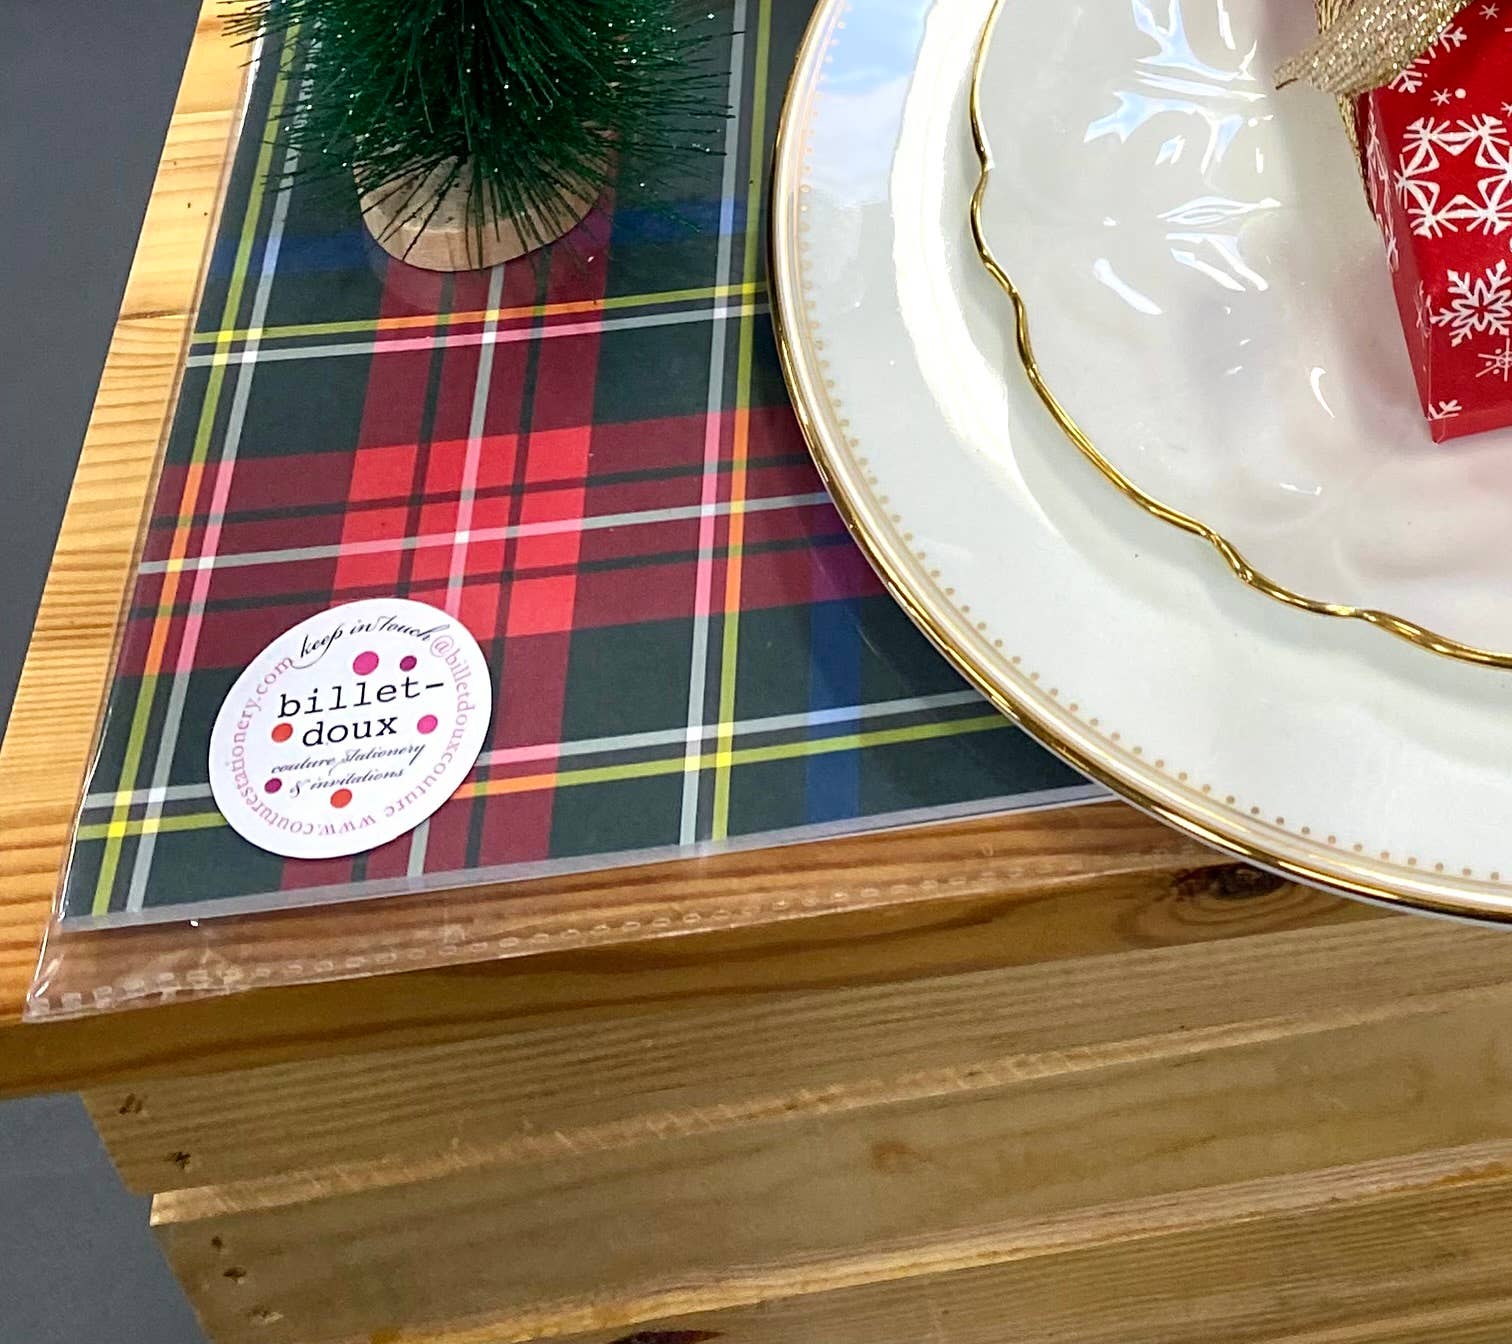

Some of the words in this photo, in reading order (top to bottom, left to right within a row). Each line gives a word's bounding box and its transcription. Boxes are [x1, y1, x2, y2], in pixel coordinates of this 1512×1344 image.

[291, 623, 343, 670] keep
[277, 675, 445, 719] billet-
[301, 715, 399, 747] doux
[289, 780, 310, 798] &
[310, 767, 404, 791] invitations
